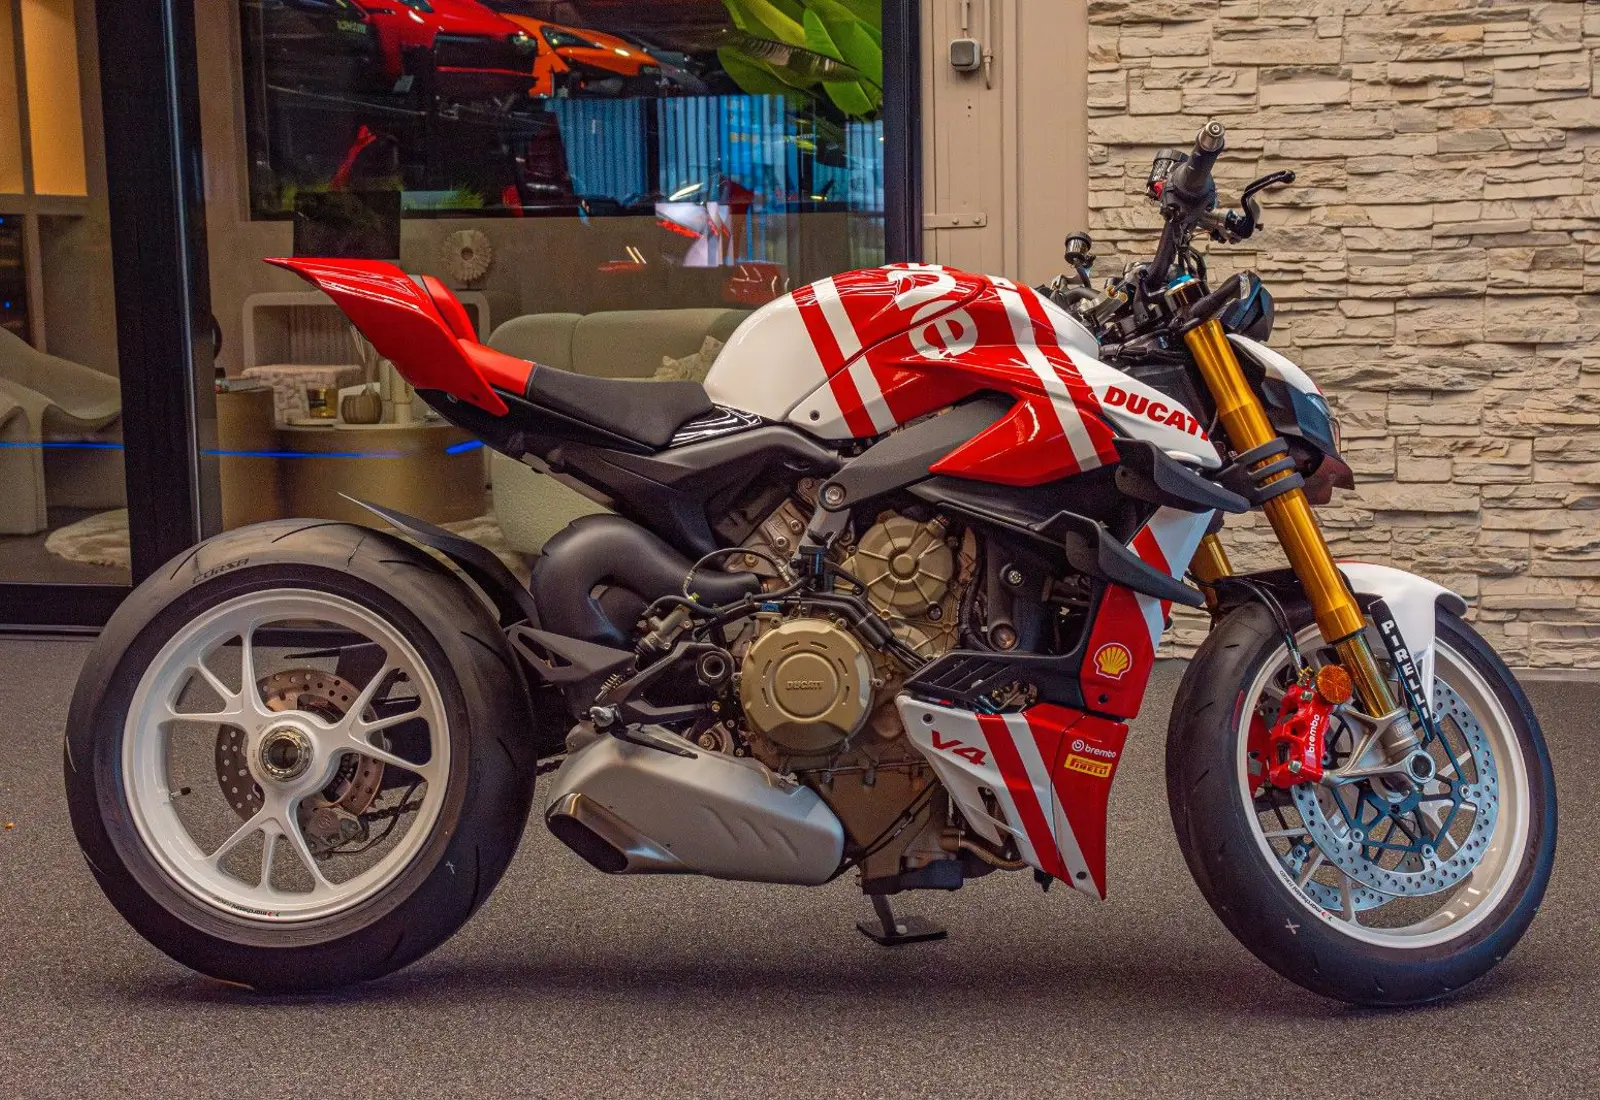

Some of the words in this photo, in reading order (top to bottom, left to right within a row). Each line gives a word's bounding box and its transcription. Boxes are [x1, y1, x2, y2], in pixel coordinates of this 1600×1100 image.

[786, 680, 825, 690] DUCATI
[1381, 619, 1429, 719] PIRELLI
[931, 730, 987, 766] V4
[1305, 713, 1320, 755] brembo
[1084, 743, 1117, 758] brembo
[1292, 885, 1321, 913] marchesini
